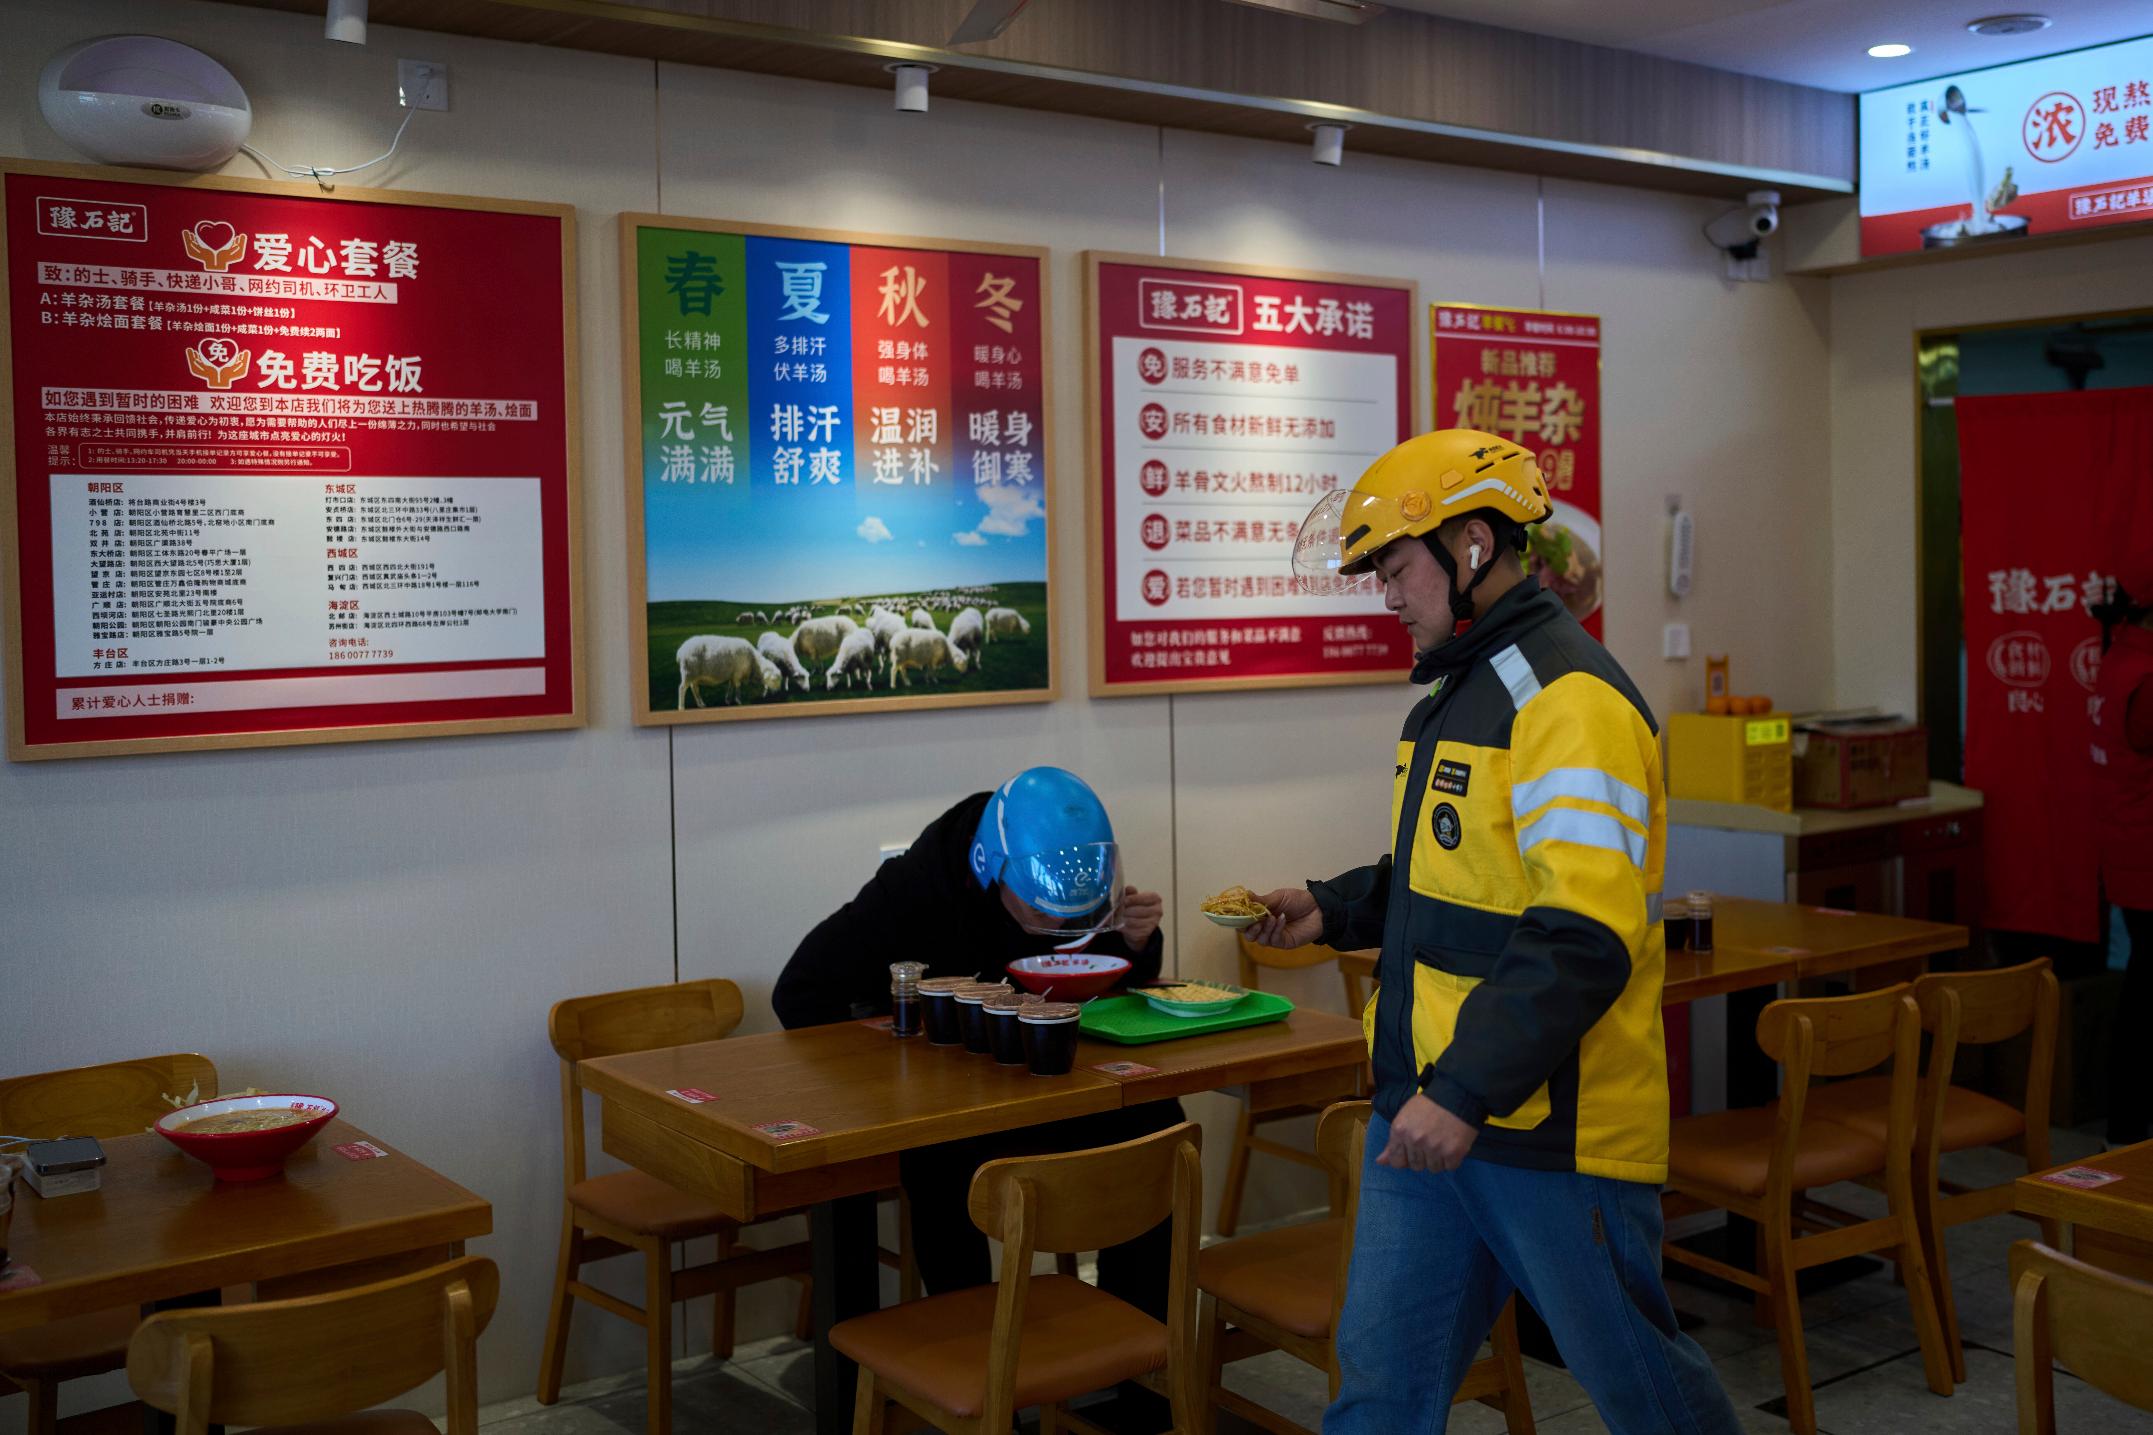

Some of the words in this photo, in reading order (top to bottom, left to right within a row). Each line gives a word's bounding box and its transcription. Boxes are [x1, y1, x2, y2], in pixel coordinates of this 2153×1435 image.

[2031, 102, 2077, 152] 浓
[2093, 114, 2150, 150] 免费
[49, 205, 134, 234] 豫石記
[253, 232, 420, 280] 爱心套餐
[664, 250, 726, 318] 春
[775, 261, 831, 325] 夏
[877, 266, 930, 328] 秋
[974, 272, 1024, 334] 冬
[1150, 290, 1233, 325] 豫石記
[1252, 296, 1375, 340] 五大承诺
[208, 342, 229, 364] 免
[665, 330, 721, 351] 长精神
[774, 335, 827, 357] 多排汗
[878, 340, 929, 360] 强身体
[974, 345, 1022, 365] 暖身心
[256, 349, 423, 393] 免费吃饭
[665, 358, 722, 379] 喝羊汤
[773, 362, 827, 384] 伏羊汤
[878, 366, 929, 387] 喝羊汤
[974, 371, 1022, 391] 喝羊汤
[1142, 352, 1164, 379] 免
[1172, 356, 1300, 385] 服务不满意免单
[45, 390, 199, 410] 如您遇到暂时的困难
[658, 401, 734, 442] 元气
[770, 404, 841, 443] 排汗
[870, 406, 938, 445] 温润
[969, 409, 1032, 446] 暖身
[1143, 407, 1166, 434] 安
[1172, 412, 1336, 440] 所有食材新鲜无添加
[660, 444, 734, 485] 满满
[772, 447, 842, 486] 舒爽
[872, 448, 940, 486] 进补
[972, 450, 1034, 486] 御寒
[1144, 465, 1168, 492] 鲜
[1174, 470, 1339, 495] 羊骨文火熬制12小时
[87, 482, 124, 493] 朝阳区
[325, 484, 357, 494] 东城区
[1144, 519, 1167, 546] 退
[326, 548, 359, 559] 西城区
[1146, 575, 1168, 601] 爱
[328, 600, 360, 611] 海淀区
[92, 648, 129, 660] 丰台区
